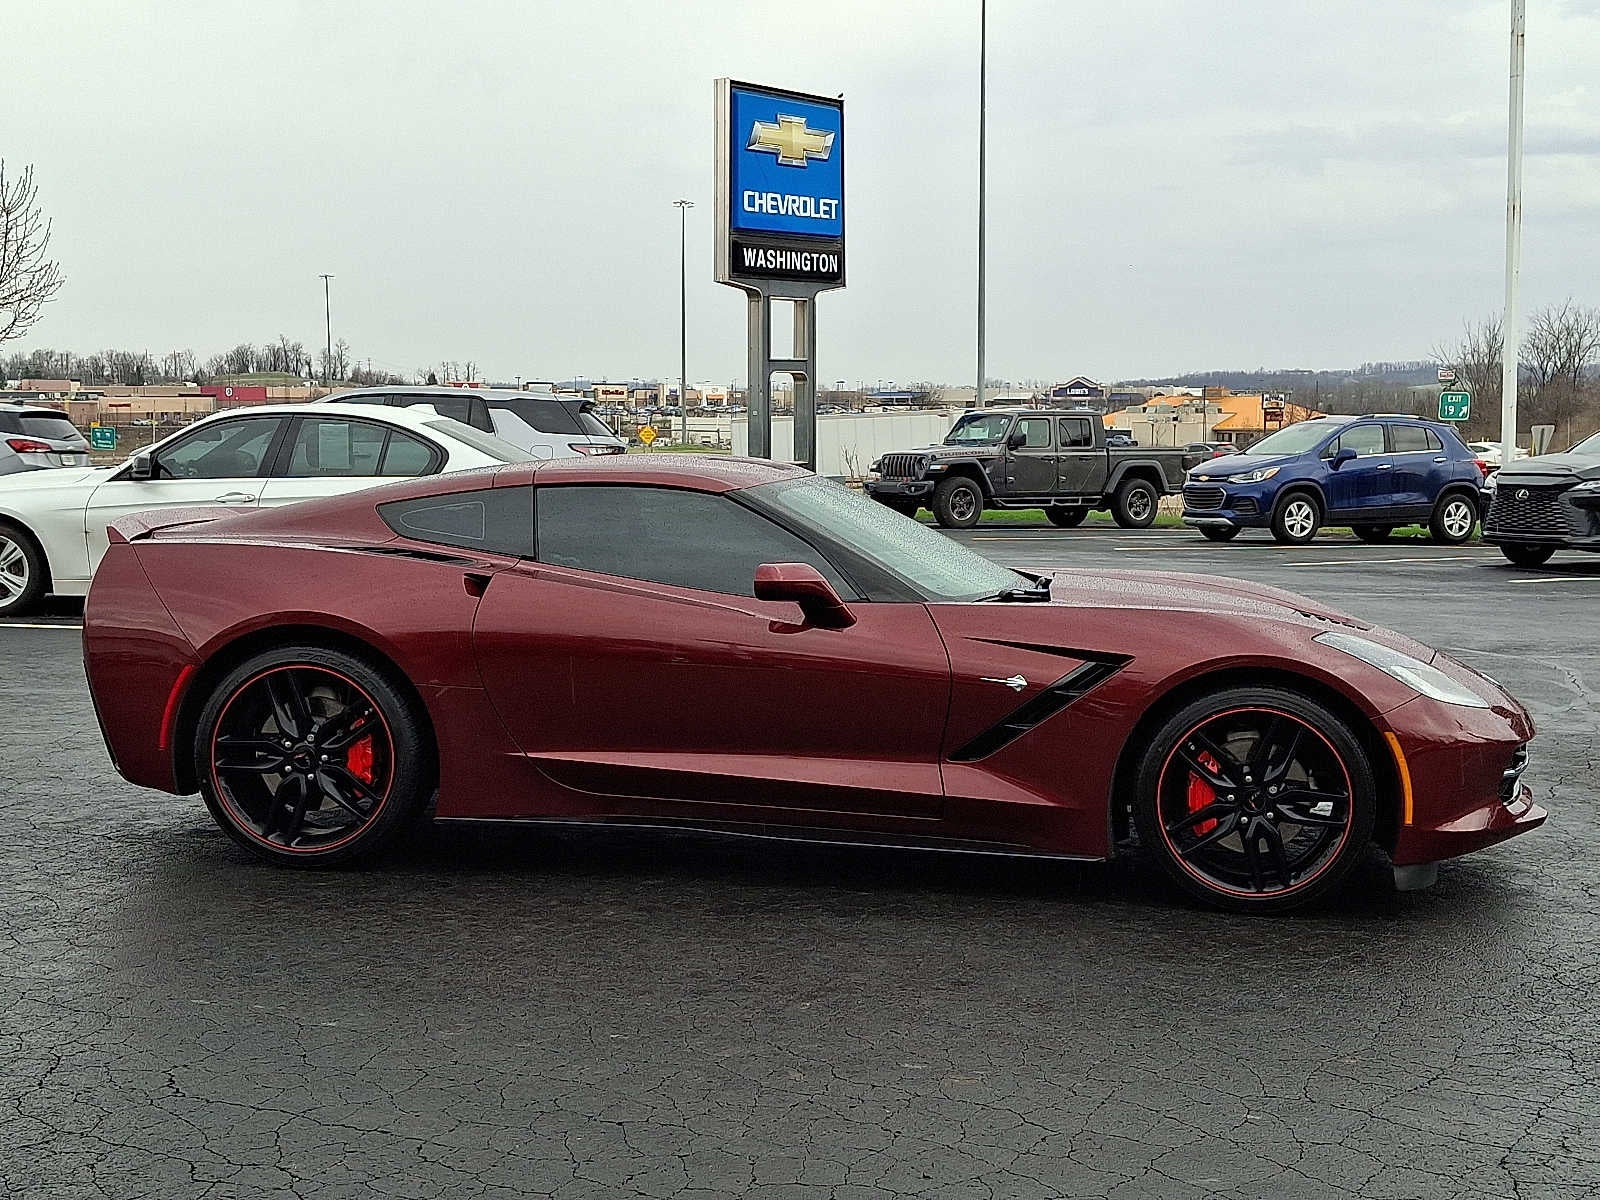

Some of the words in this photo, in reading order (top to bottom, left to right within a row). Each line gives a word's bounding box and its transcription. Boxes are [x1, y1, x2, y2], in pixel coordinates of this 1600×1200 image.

[743, 190, 839, 219] CHEVROLET
[743, 247, 838, 273] WASHINGTON
[1445, 405, 1455, 416] 19
